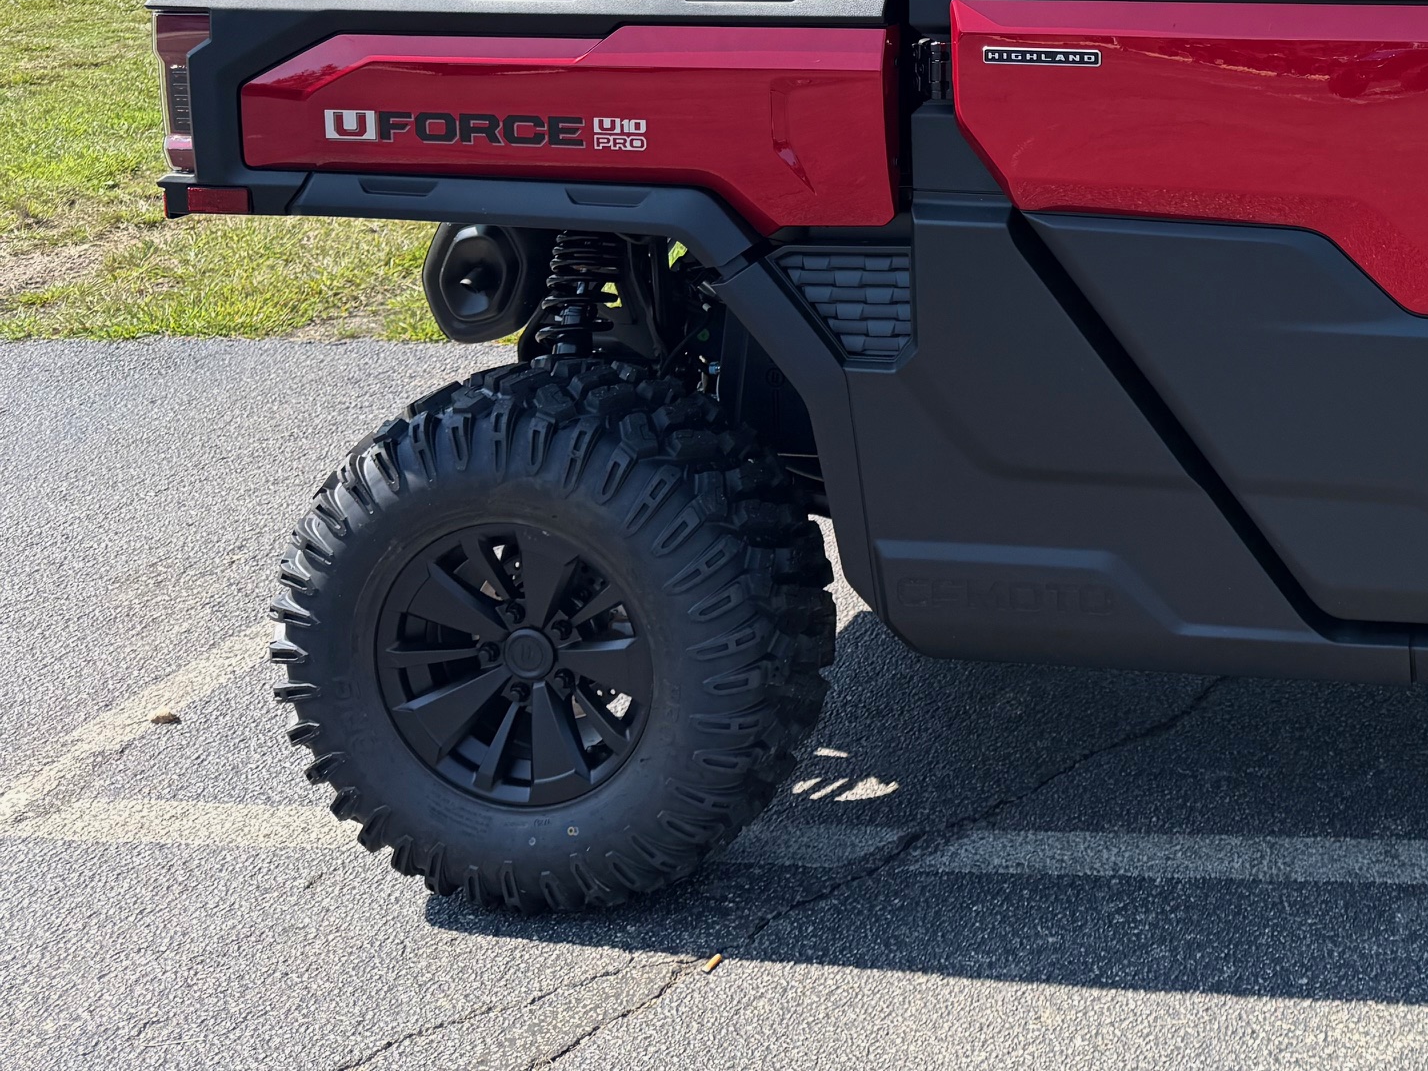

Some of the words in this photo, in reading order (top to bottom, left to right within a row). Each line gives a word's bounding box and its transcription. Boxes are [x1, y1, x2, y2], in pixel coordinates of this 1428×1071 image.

[987, 52, 1096, 62] HIGHLAND
[593, 117, 647, 133] U10
[593, 135, 647, 151] PRO
